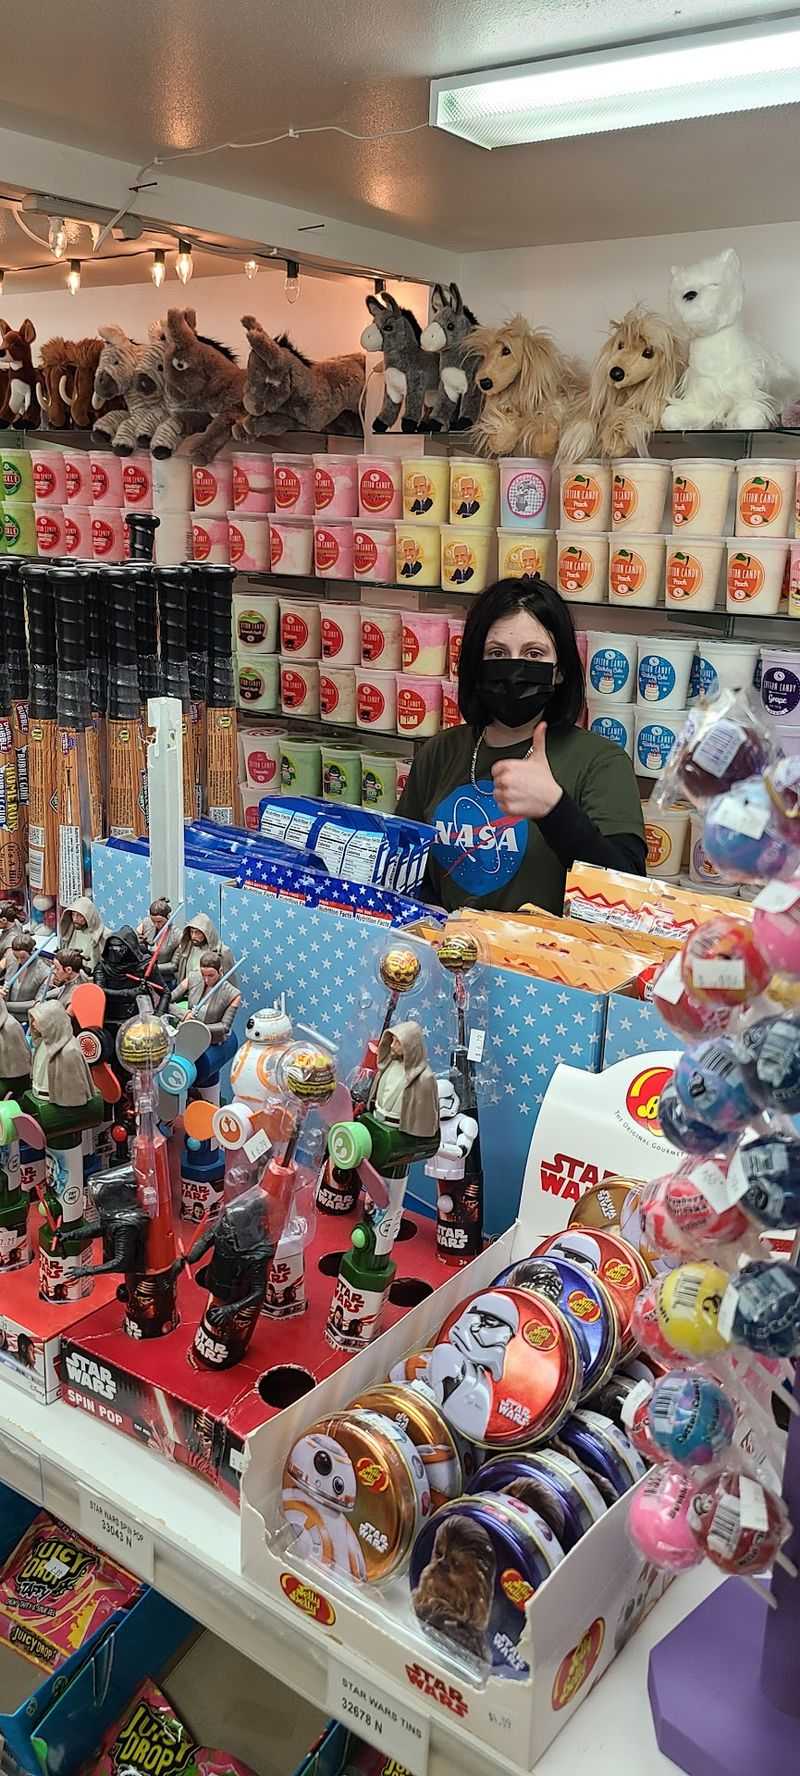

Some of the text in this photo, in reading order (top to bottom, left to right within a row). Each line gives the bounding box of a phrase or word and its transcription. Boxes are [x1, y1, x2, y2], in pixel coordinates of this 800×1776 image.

[768, 693, 788, 704] Grape
[779, 682, 797, 693] CANDY
[16, 704, 28, 732] BUBBLE
[17, 753, 28, 803] BUBBLE GUM
[6, 766, 18, 829] HOME RUN
[435, 820, 521, 853] NASA
[318, 1197, 355, 1212] WARS
[319, 1190, 354, 1206] STAR
[66, 1352, 117, 1388] STAR
[66, 1364, 118, 1401] WARS
[67, 1388, 123, 1426] SPIN POP
[38, 1542, 93, 1574] UICY
[405, 1662, 464, 1701] STAR
[406, 1670, 470, 1718] WARS
[341, 1677, 423, 1739] STAR WARS TINS
[341, 1697, 384, 1735] 32678 N
[120, 1732, 175, 1776] DROP
